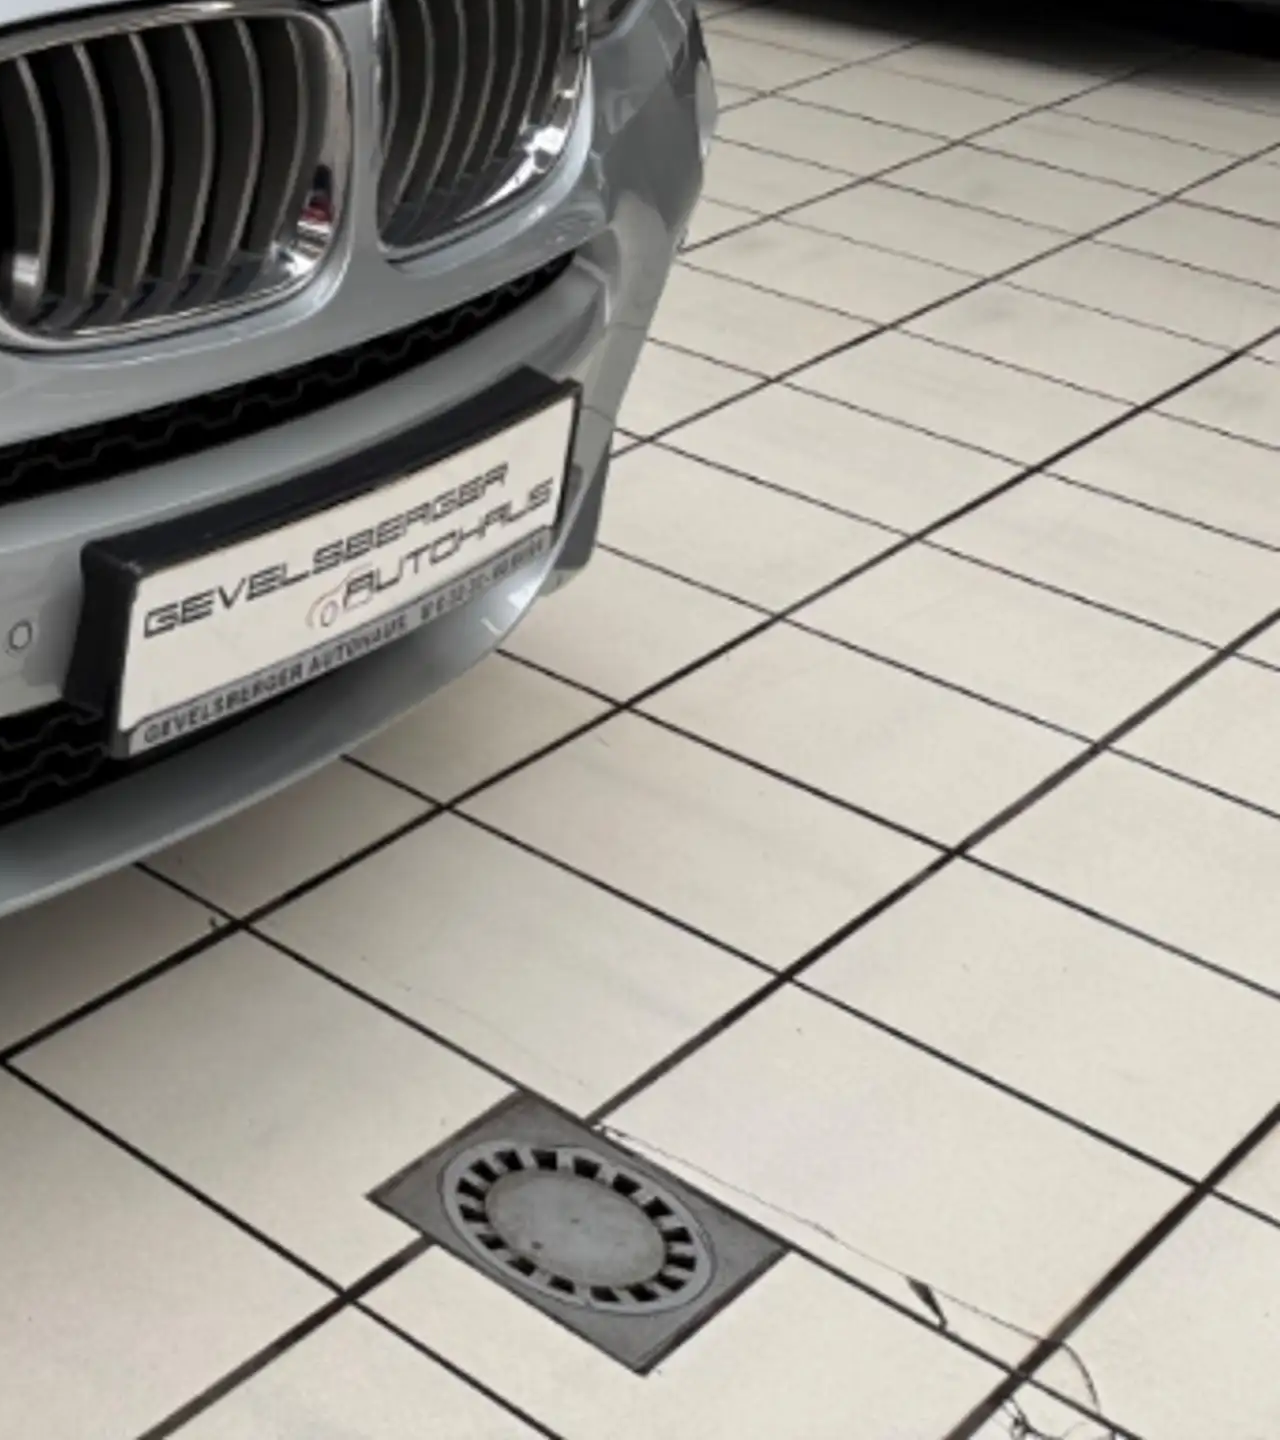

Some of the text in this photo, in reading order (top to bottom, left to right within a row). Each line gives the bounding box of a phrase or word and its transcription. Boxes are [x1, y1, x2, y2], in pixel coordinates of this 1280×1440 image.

[143, 463, 510, 640] GEVELSBERGER
[342, 478, 553, 609] AUTOHAUS
[143, 612, 408, 745] GEVELSBERGER AUTOHAUS
